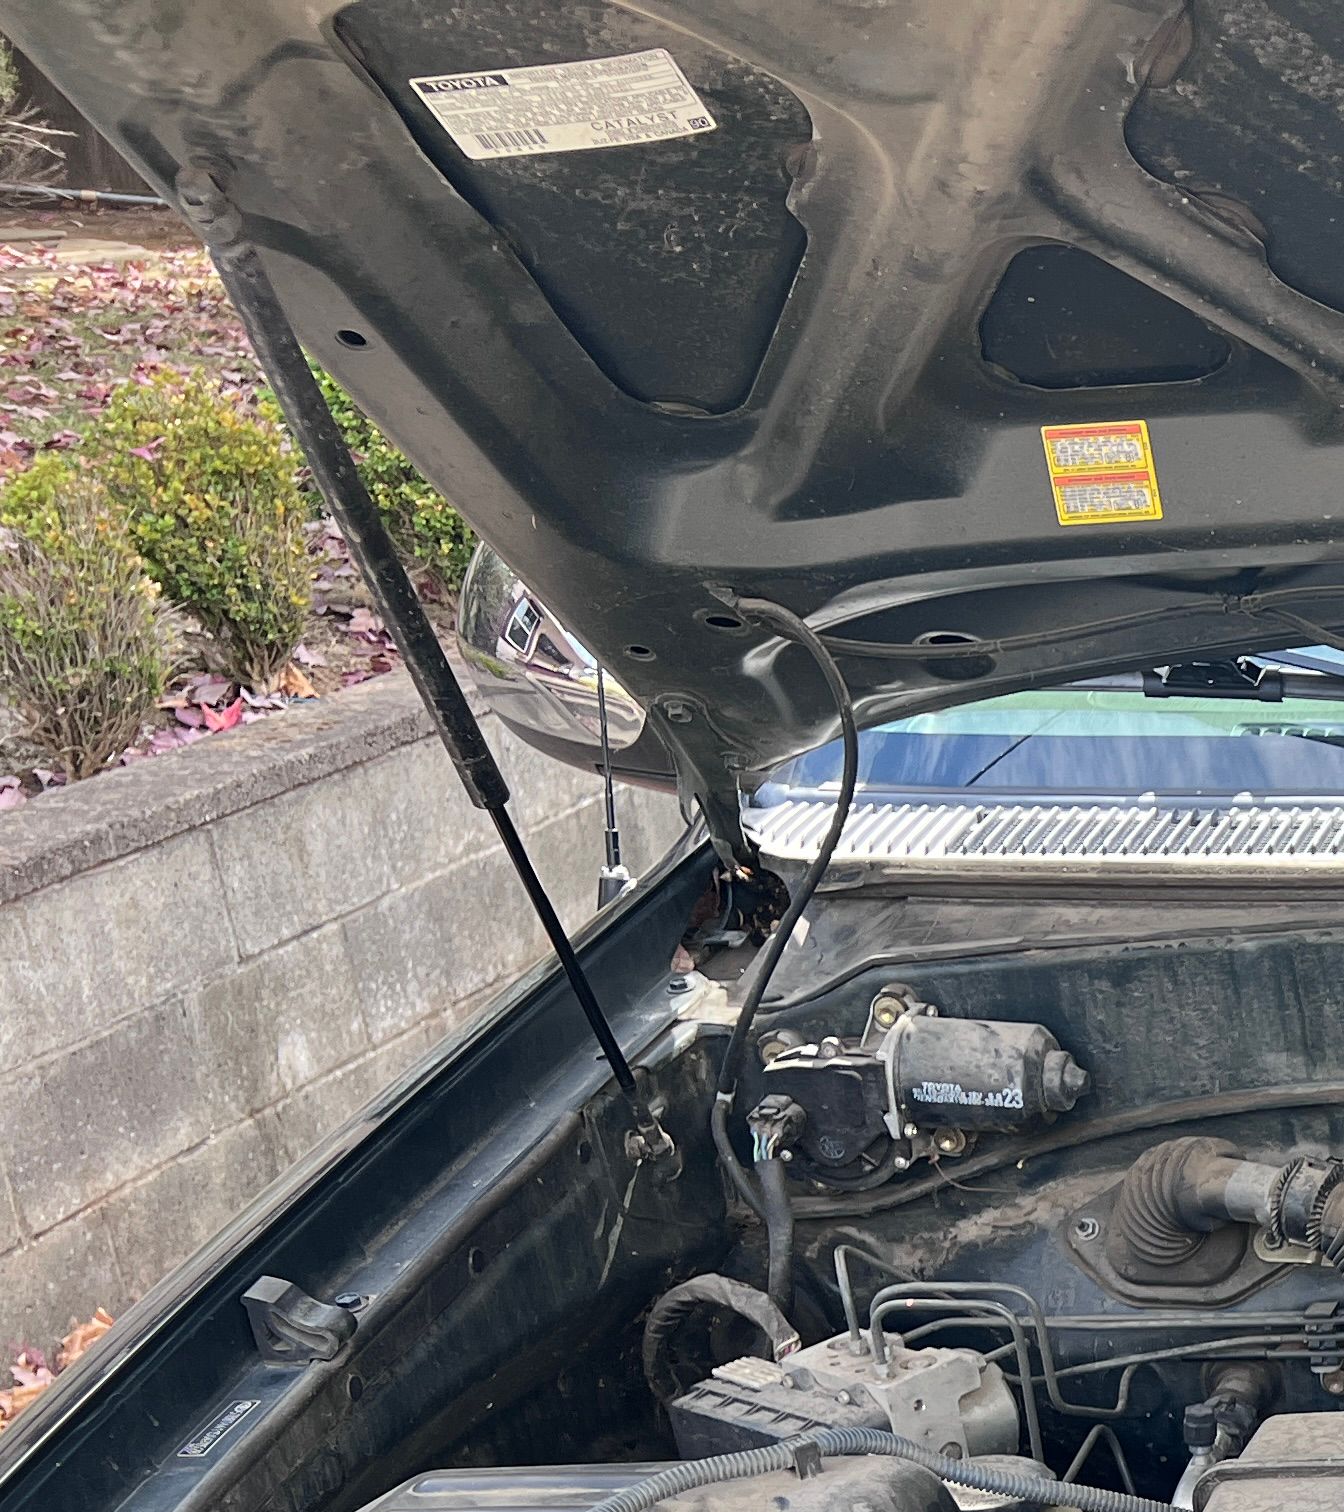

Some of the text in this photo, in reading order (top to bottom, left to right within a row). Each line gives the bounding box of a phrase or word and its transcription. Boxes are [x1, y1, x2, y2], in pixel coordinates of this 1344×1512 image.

[427, 76, 499, 91] TOYOTA
[591, 110, 677, 130] CATALYST
[690, 118, 709, 129] 90
[922, 1082, 962, 1093] TOYOTA
[1002, 1088, 1023, 1109] 23
